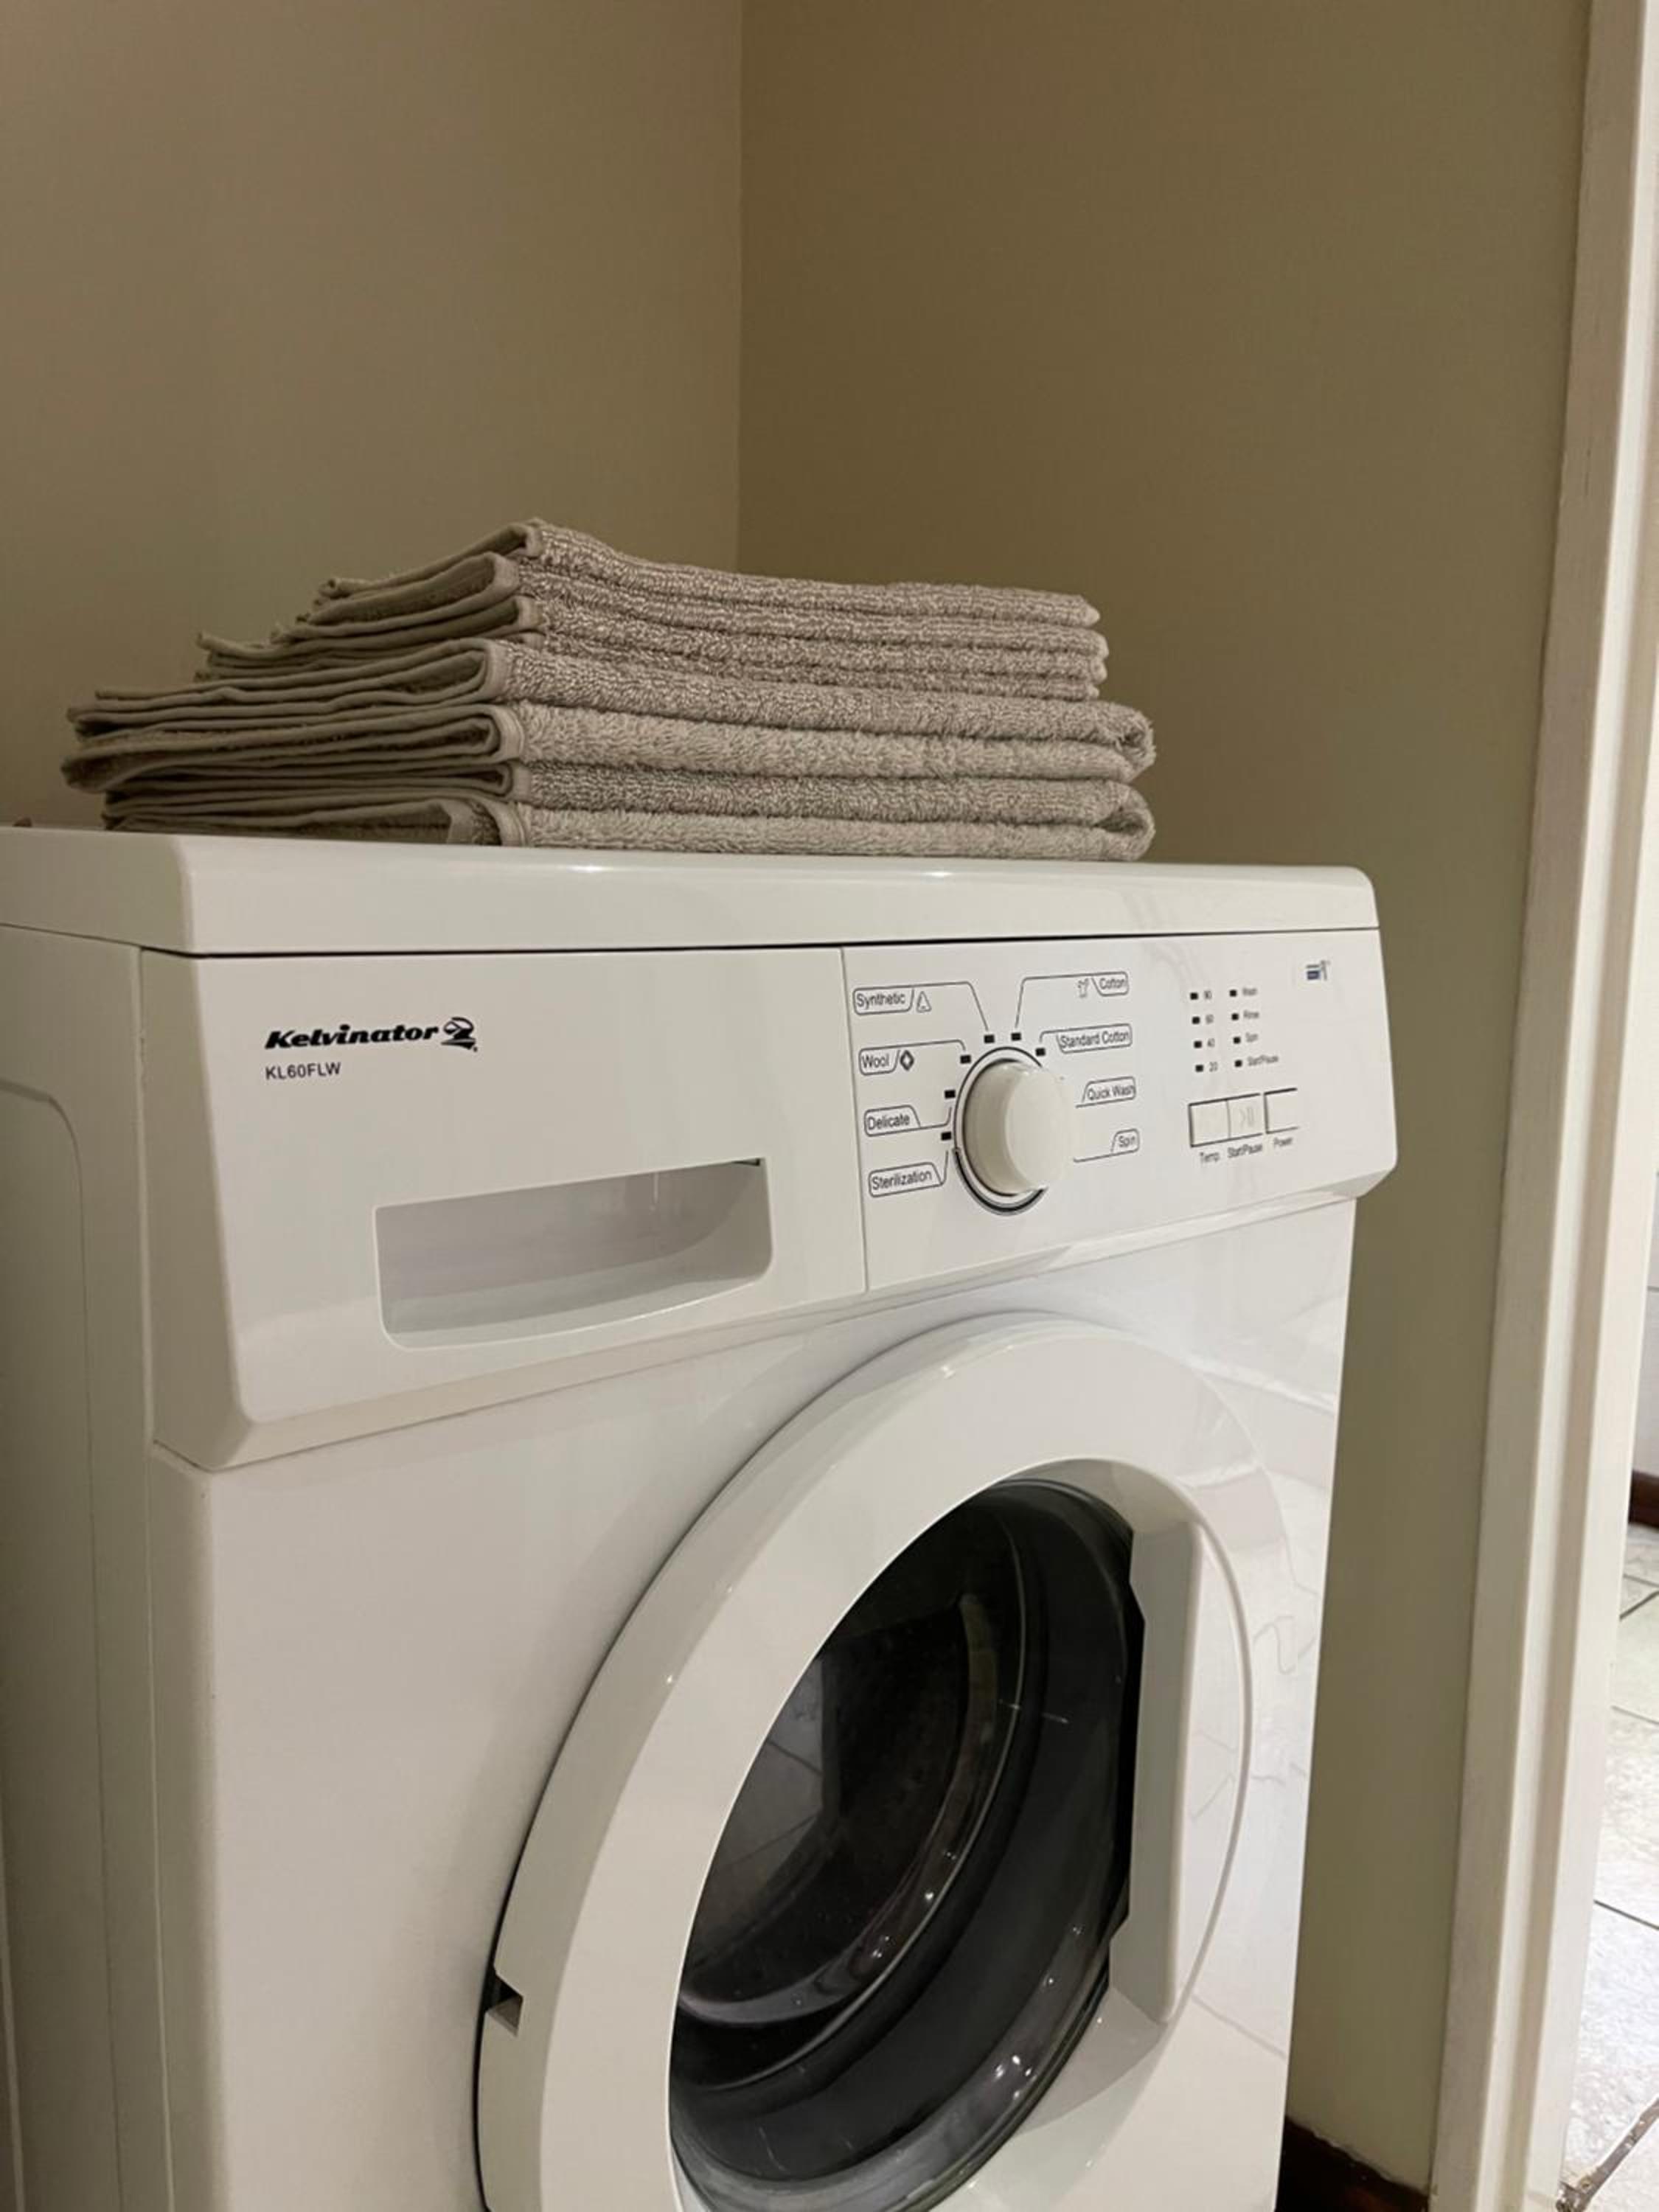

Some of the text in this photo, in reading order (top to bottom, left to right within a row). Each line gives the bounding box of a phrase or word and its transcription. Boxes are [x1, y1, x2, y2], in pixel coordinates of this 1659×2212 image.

[1099, 977, 1127, 990] Cotton
[855, 991, 906, 1008] Synthetic
[265, 1023, 439, 1049] Kelvinator
[1060, 1030, 1130, 1049] Standard Cotton
[861, 1053, 890, 1069] Wool
[265, 1062, 341, 1080] KL60FLW
[1086, 1085, 1135, 1101] Quick Wash
[866, 1113, 911, 1130] Delicate
[1118, 1135, 1136, 1150] Spin
[871, 1168, 933, 1191] Sterilization
